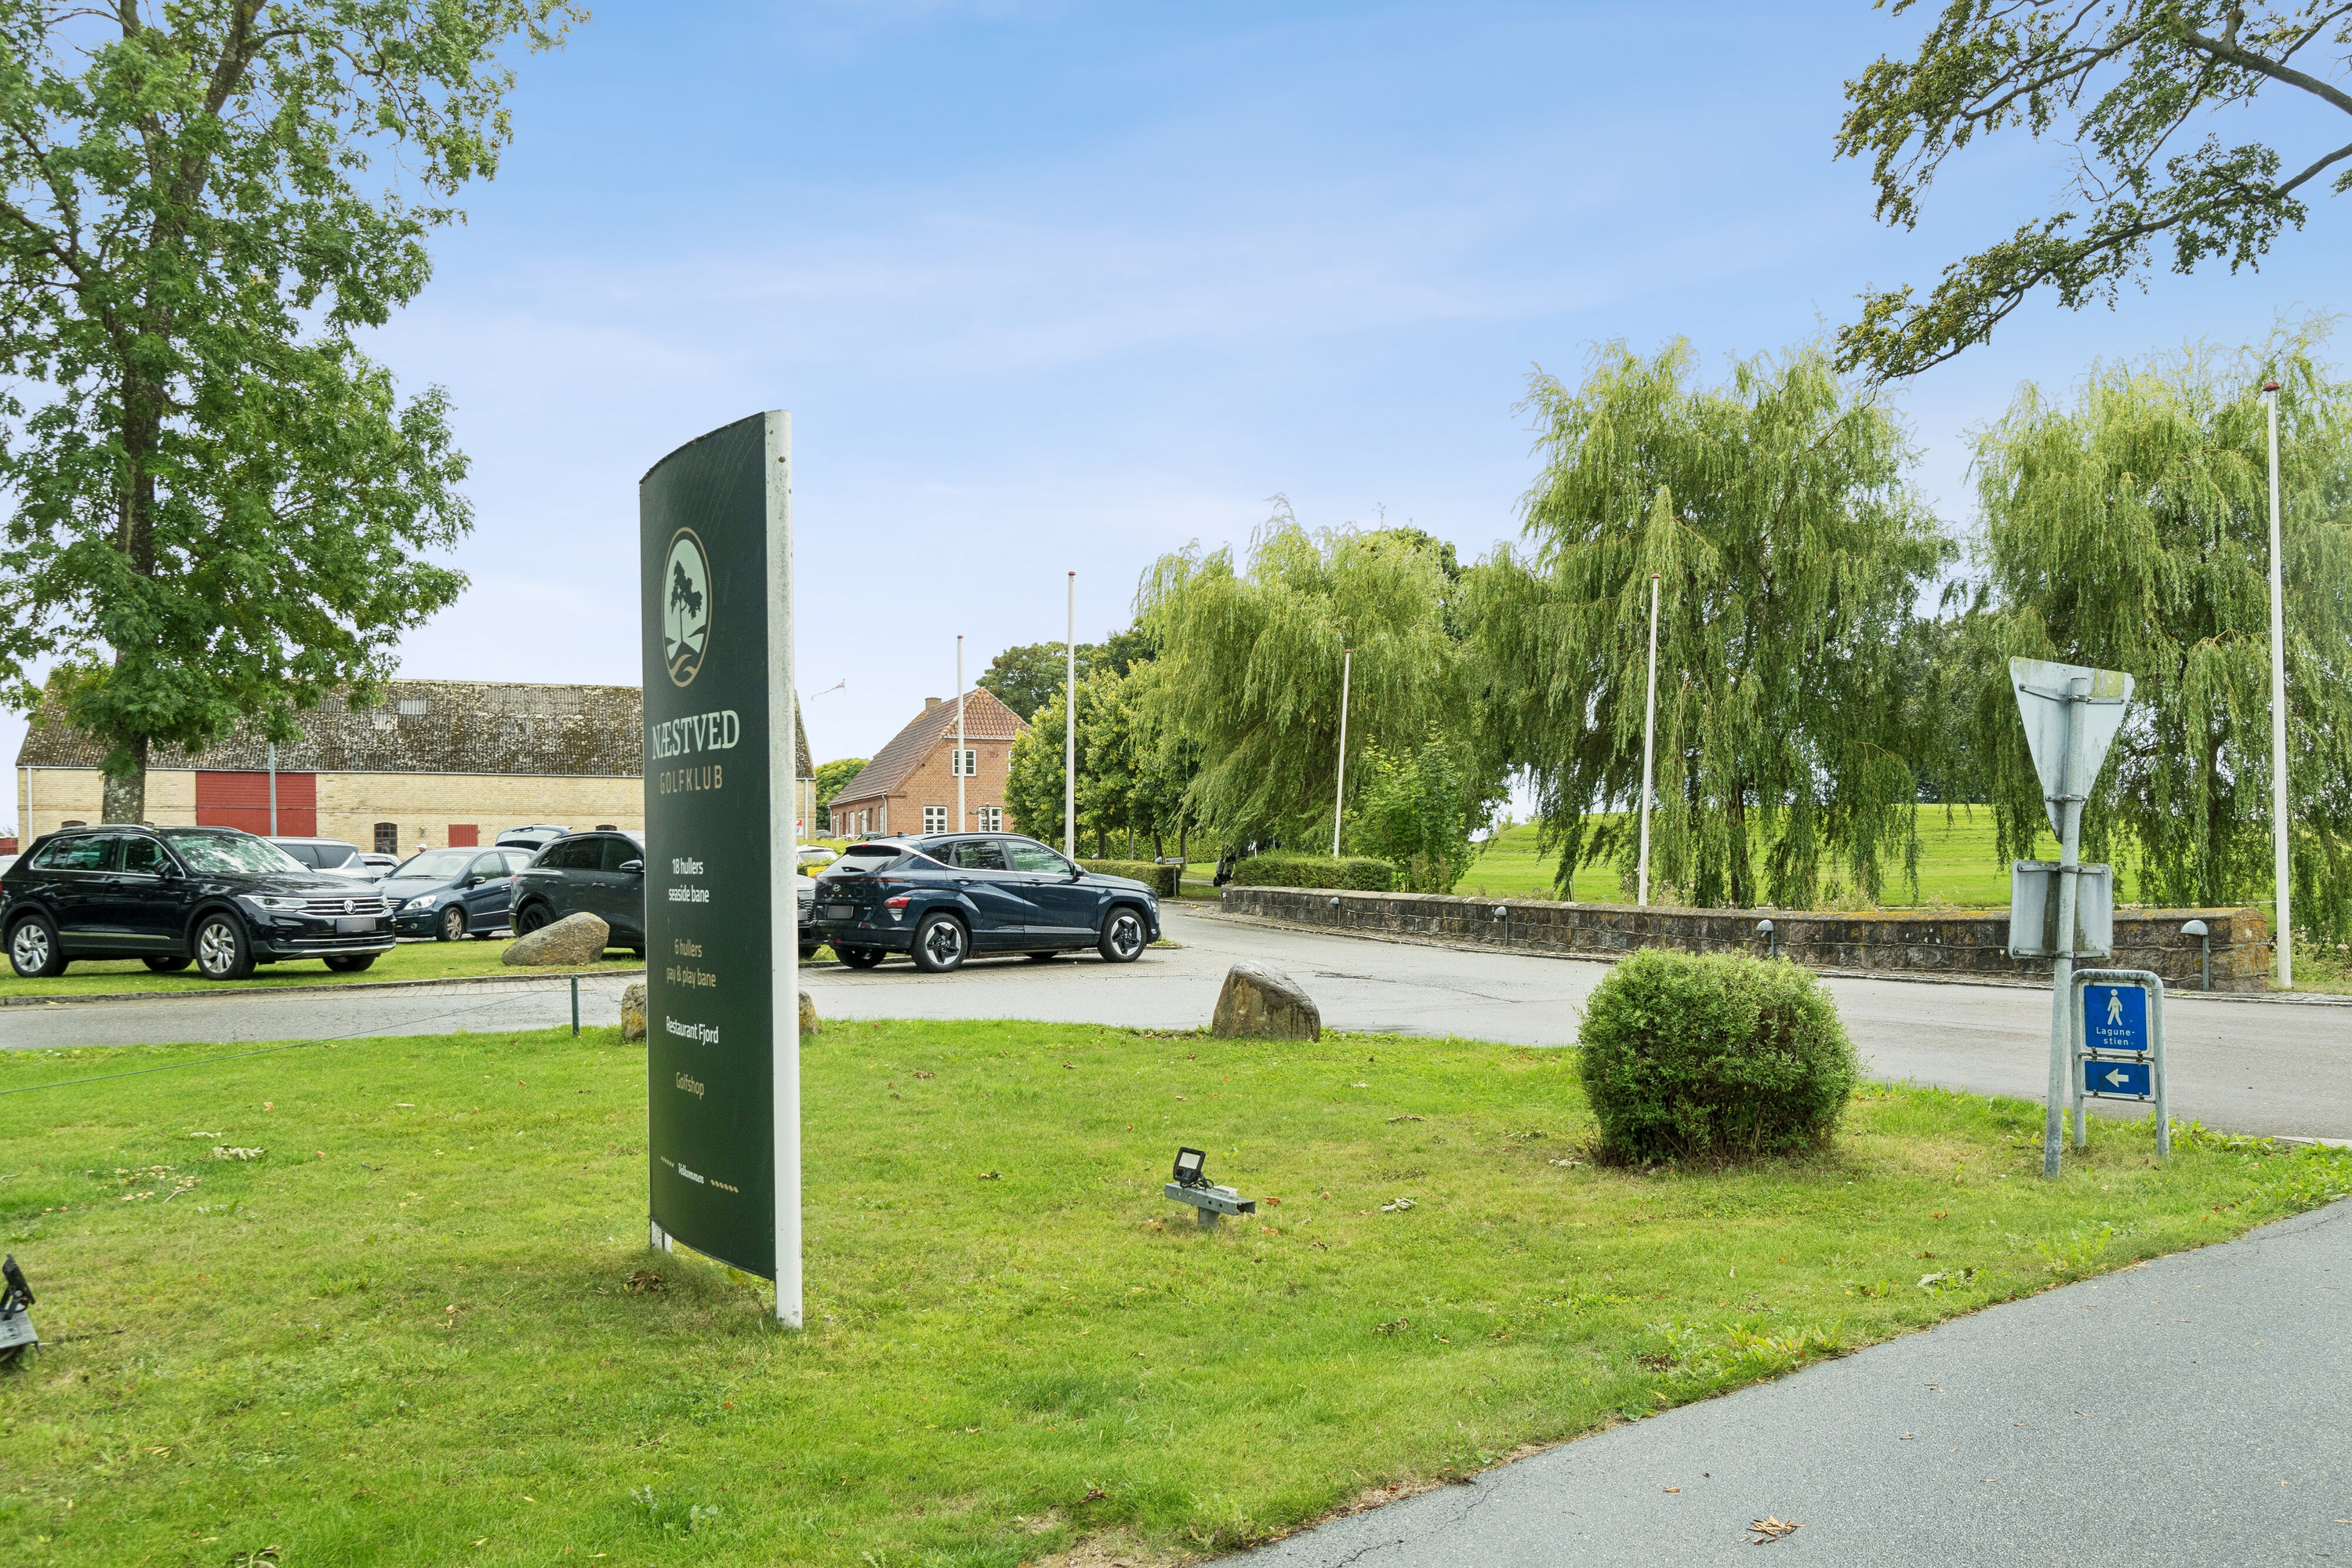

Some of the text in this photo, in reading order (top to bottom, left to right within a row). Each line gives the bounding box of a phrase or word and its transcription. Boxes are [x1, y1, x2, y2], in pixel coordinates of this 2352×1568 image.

[652, 710, 740, 760] NÆSTVED
[660, 764, 723, 795] GOLFKLUB
[672, 857, 703, 875] 18 hullers
[669, 884, 710, 902] seaside bane
[674, 938, 702, 957] 6 hullers
[666, 964, 717, 989] pay & play bane
[666, 1015, 719, 1046] Restaurant Fjord
[2096, 1026, 2136, 1036] Lagune-
[2103, 1037, 2129, 1046] stien
[676, 1072, 705, 1100] Golfshop
